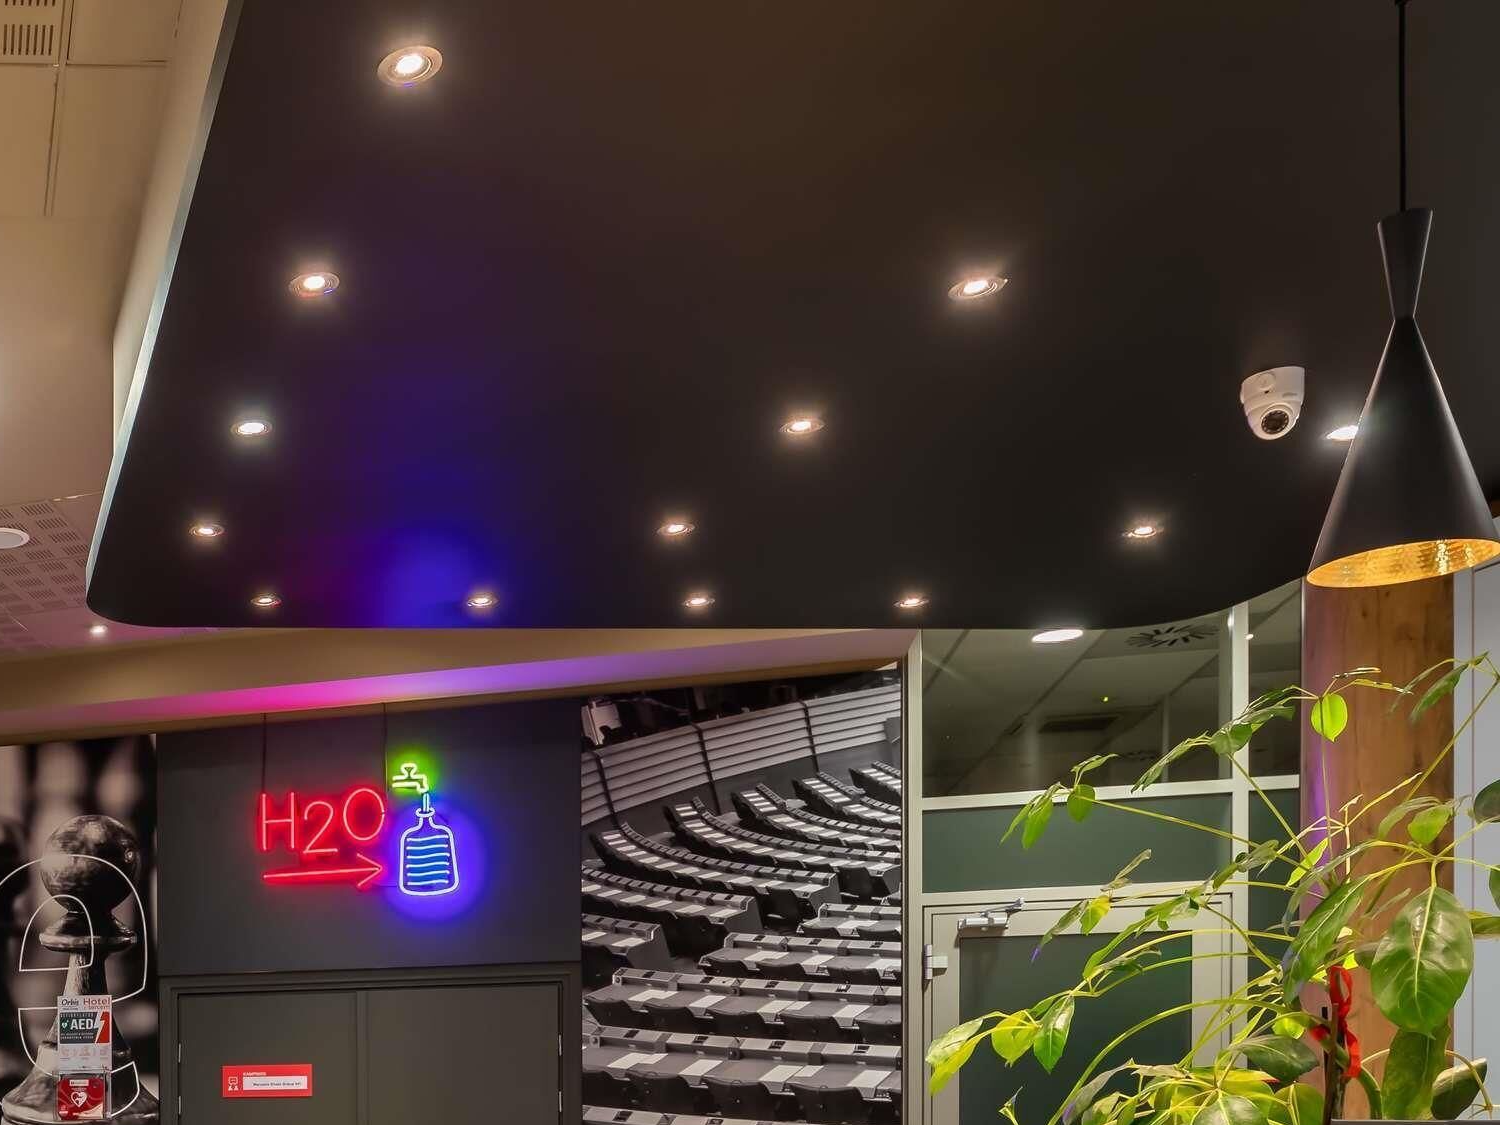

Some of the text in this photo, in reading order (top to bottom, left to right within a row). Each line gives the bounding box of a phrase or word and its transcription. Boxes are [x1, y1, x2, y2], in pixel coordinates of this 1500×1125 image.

[261, 787, 386, 854] H2O
[83, 997, 111, 1006] Hotel
[70, 1018, 94, 1030] AED
